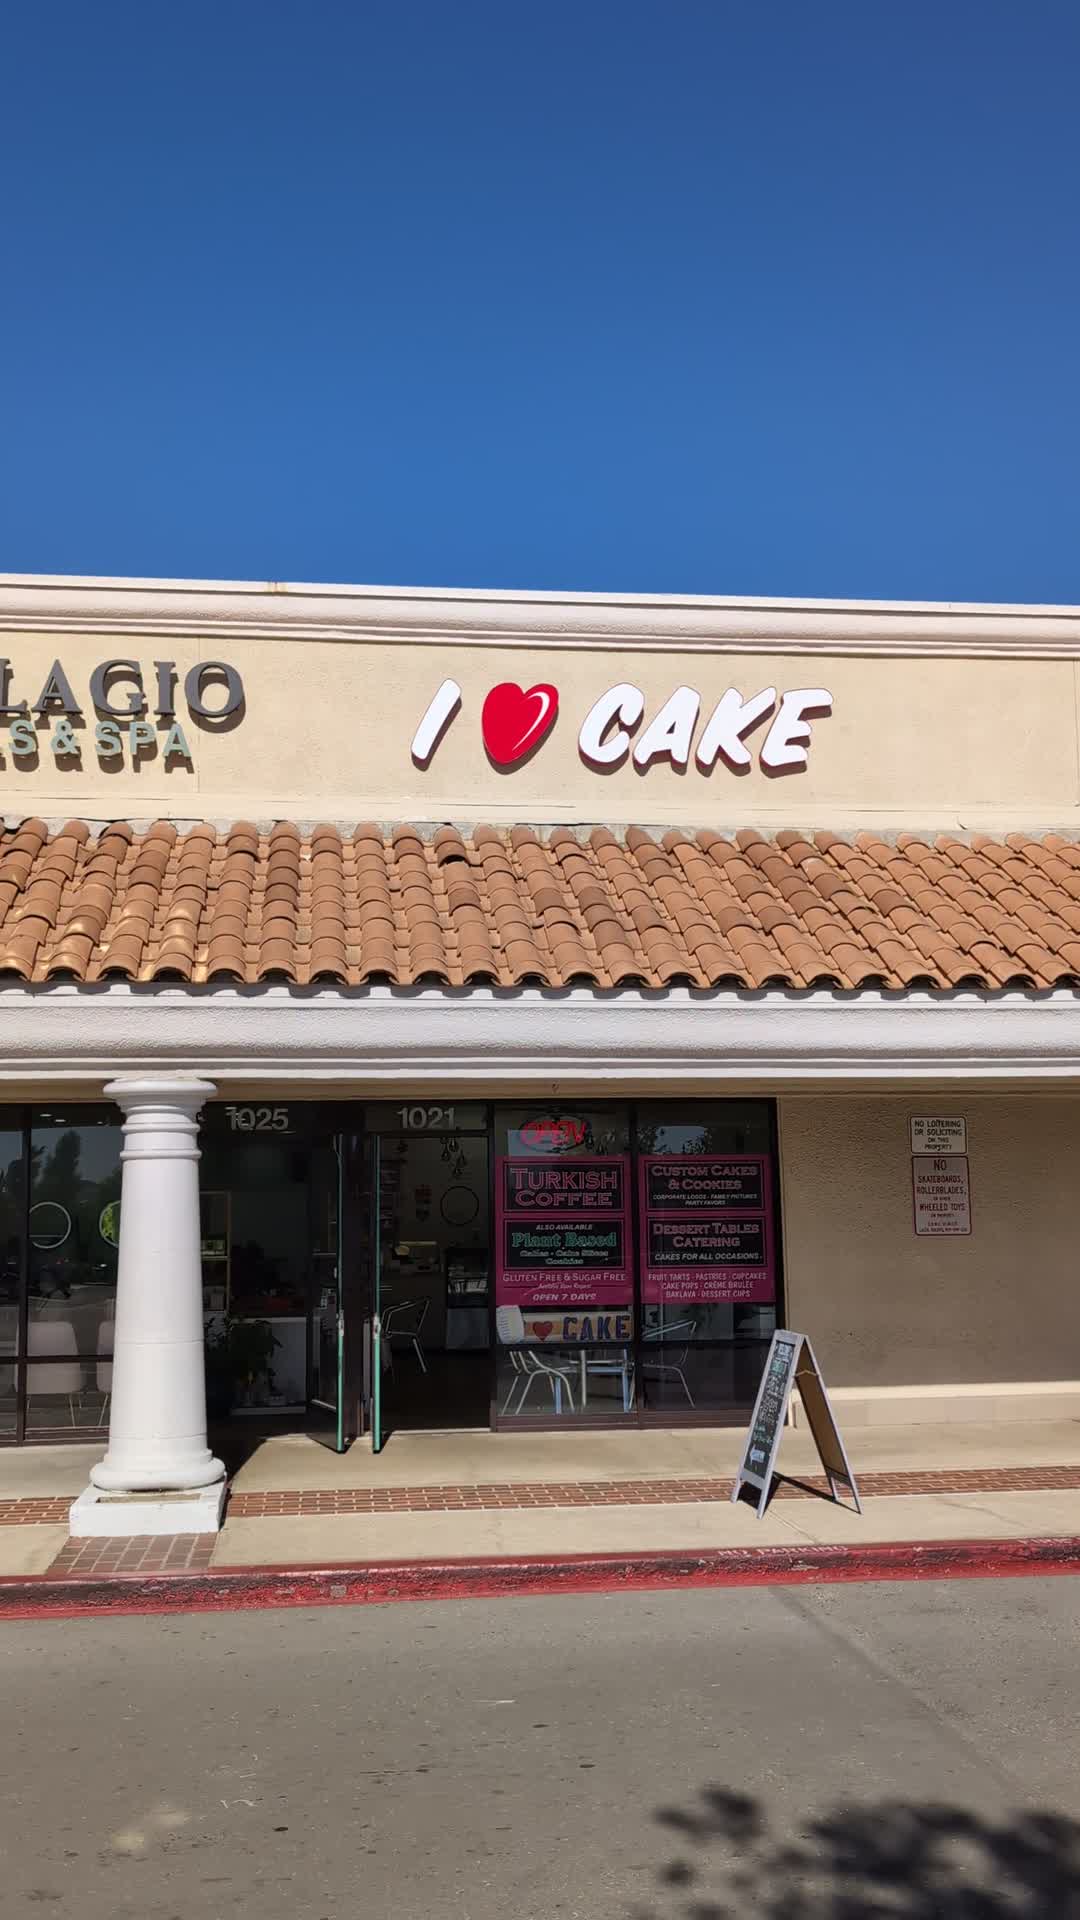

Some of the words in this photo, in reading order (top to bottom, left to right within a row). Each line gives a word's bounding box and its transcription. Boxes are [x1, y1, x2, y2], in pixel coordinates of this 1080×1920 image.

[411, 678, 461, 762] I
[578, 682, 834, 770] CAKE
[50, 721, 78, 755] &
[95, 721, 192, 758] SPA
[224, 1107, 289, 1131] 1025
[397, 1106, 456, 1130] 1021
[914, 1119, 924, 1128] NO
[520, 1119, 587, 1146] OPEN
[933, 1159, 947, 1171] NO
[509, 1167, 618, 1190] TURKISH
[668, 1178, 680, 1190] &
[682, 1178, 742, 1190] COOKIES
[514, 1190, 613, 1207] COFFEE
[653, 1223, 711, 1235] DESSERT
[711, 1222, 760, 1234] TABLES
[511, 1232, 562, 1248] Plant
[672, 1236, 741, 1248] CATERING
[654, 1253, 681, 1261] CAKES
[539, 1272, 562, 1281] FREE
[572, 1272, 602, 1281] SUGAR
[603, 1272, 627, 1281] FREE
[532, 1293, 559, 1302] OPEN
[561, 1293, 569, 1301] 7
[570, 1293, 597, 1301] DAYS
[562, 1315, 631, 1341] CAKE
